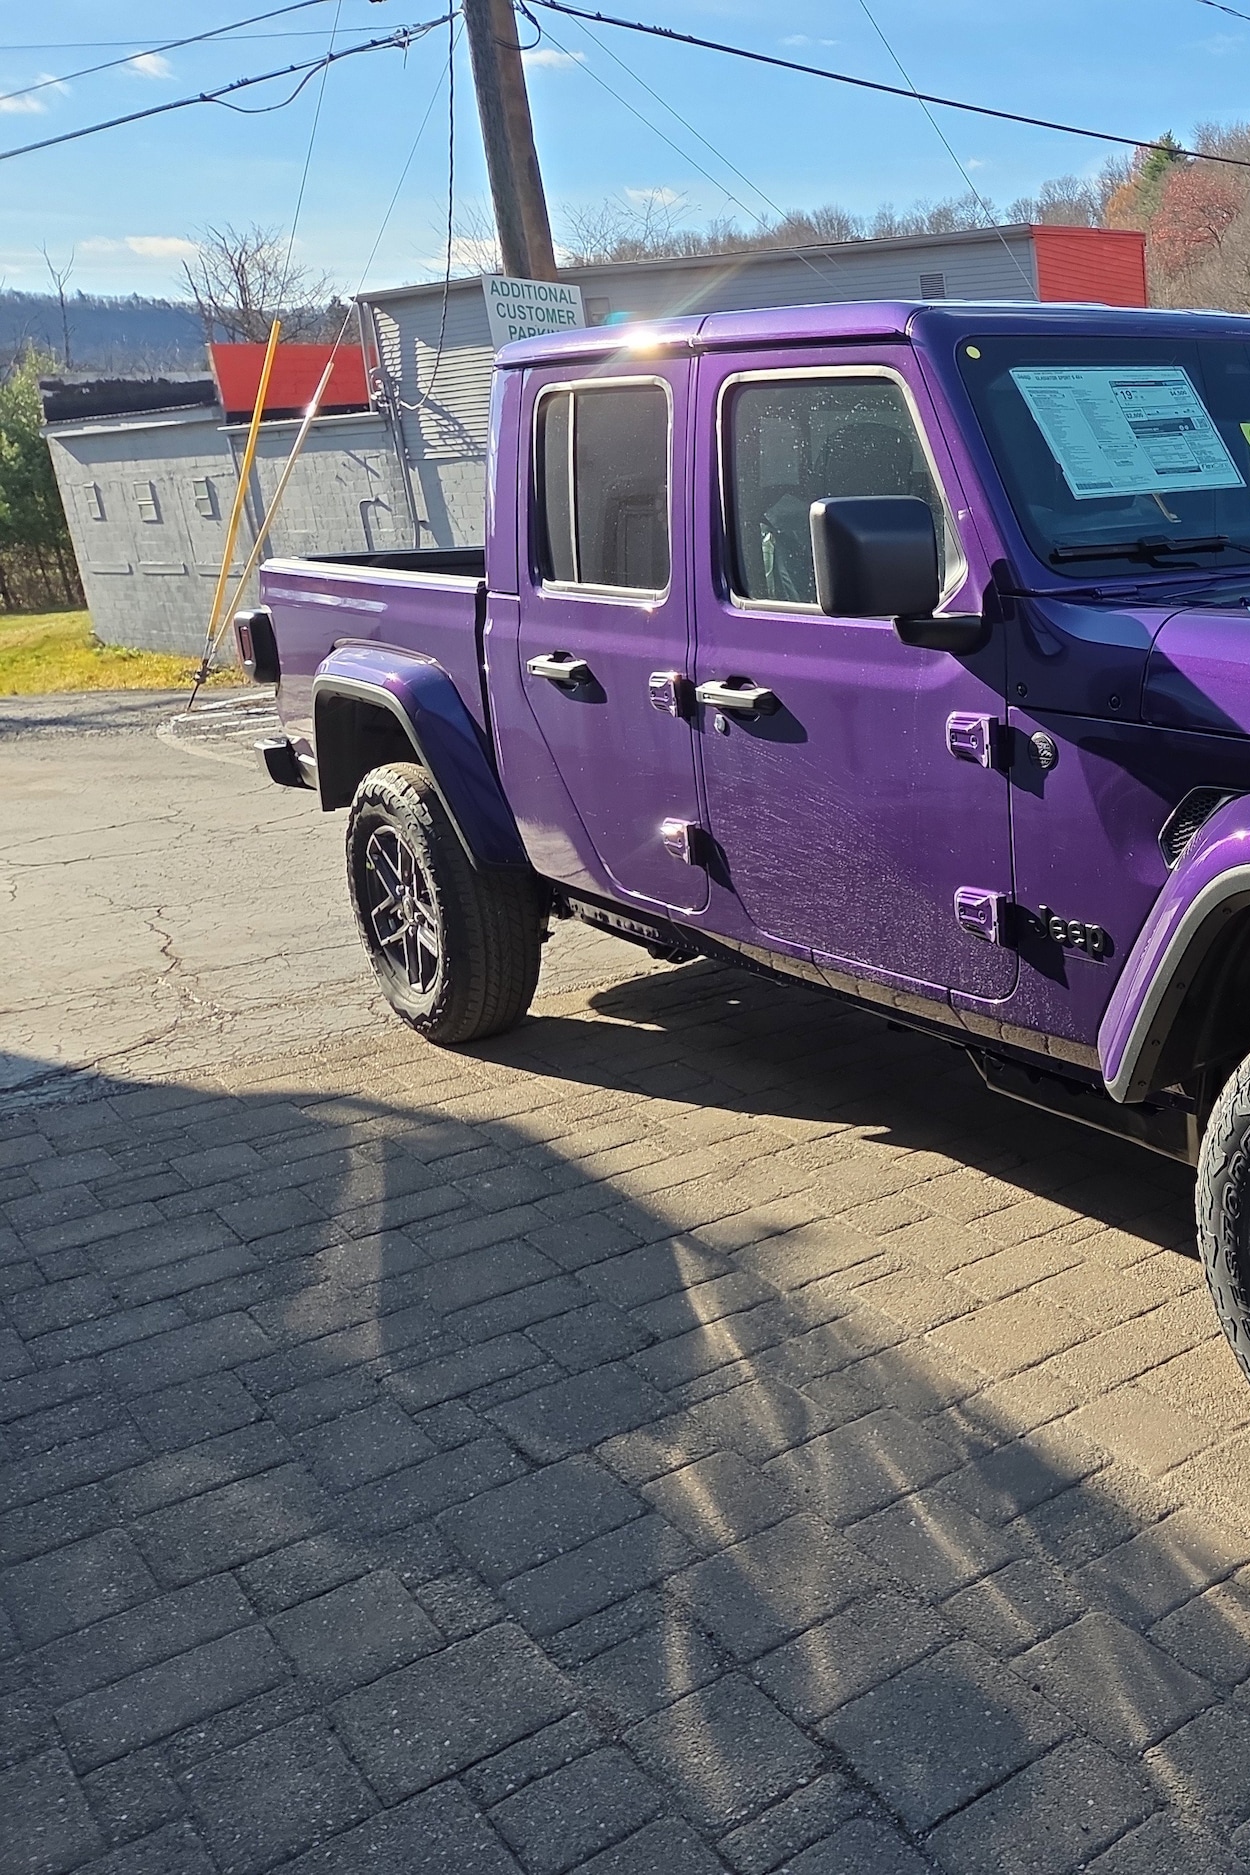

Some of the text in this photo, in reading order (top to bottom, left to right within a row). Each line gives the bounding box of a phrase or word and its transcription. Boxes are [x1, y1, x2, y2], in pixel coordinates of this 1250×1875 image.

[490, 280, 577, 305] ADDITIONAL
[496, 302, 577, 326] CUSTOMER
[508, 325, 561, 340] PARK
[1120, 390, 1133, 400] 19
[1027, 903, 1104, 955] Jeep
